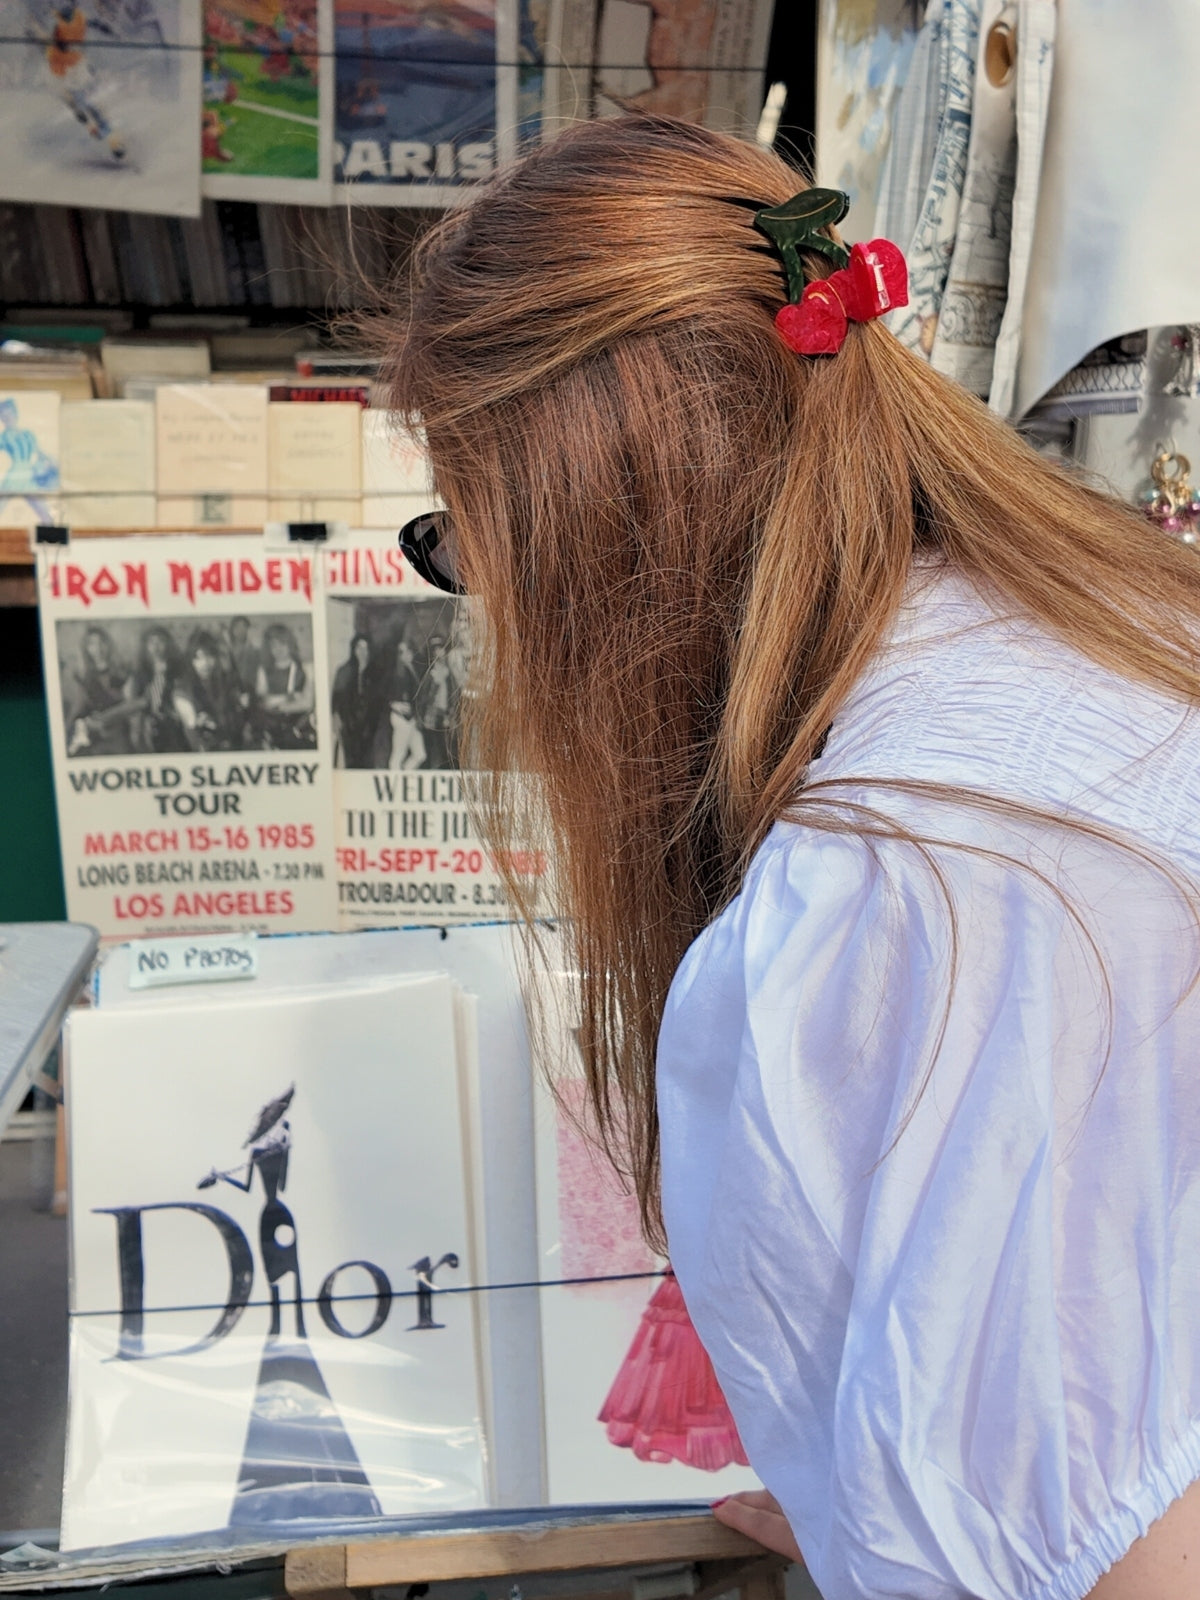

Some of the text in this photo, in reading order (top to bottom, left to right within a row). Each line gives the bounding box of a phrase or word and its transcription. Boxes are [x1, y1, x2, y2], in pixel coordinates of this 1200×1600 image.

[51, 559, 313, 608] IRON MAIDEN
[68, 763, 320, 792] WORLD SLAVERY
[153, 792, 243, 817] TOUR
[344, 809, 376, 838] TO
[384, 809, 433, 838] THE
[84, 823, 316, 856] MARCH 15-16 1985
[77, 863, 131, 888] LONG
[135, 861, 194, 885] BEACH
[199, 858, 261, 882] ARENA
[113, 889, 296, 920] LOS ANGELES
[337, 881, 456, 905] TROUBADOUR
[137, 949, 169, 972] NO
[91, 1202, 460, 1363] Dior
